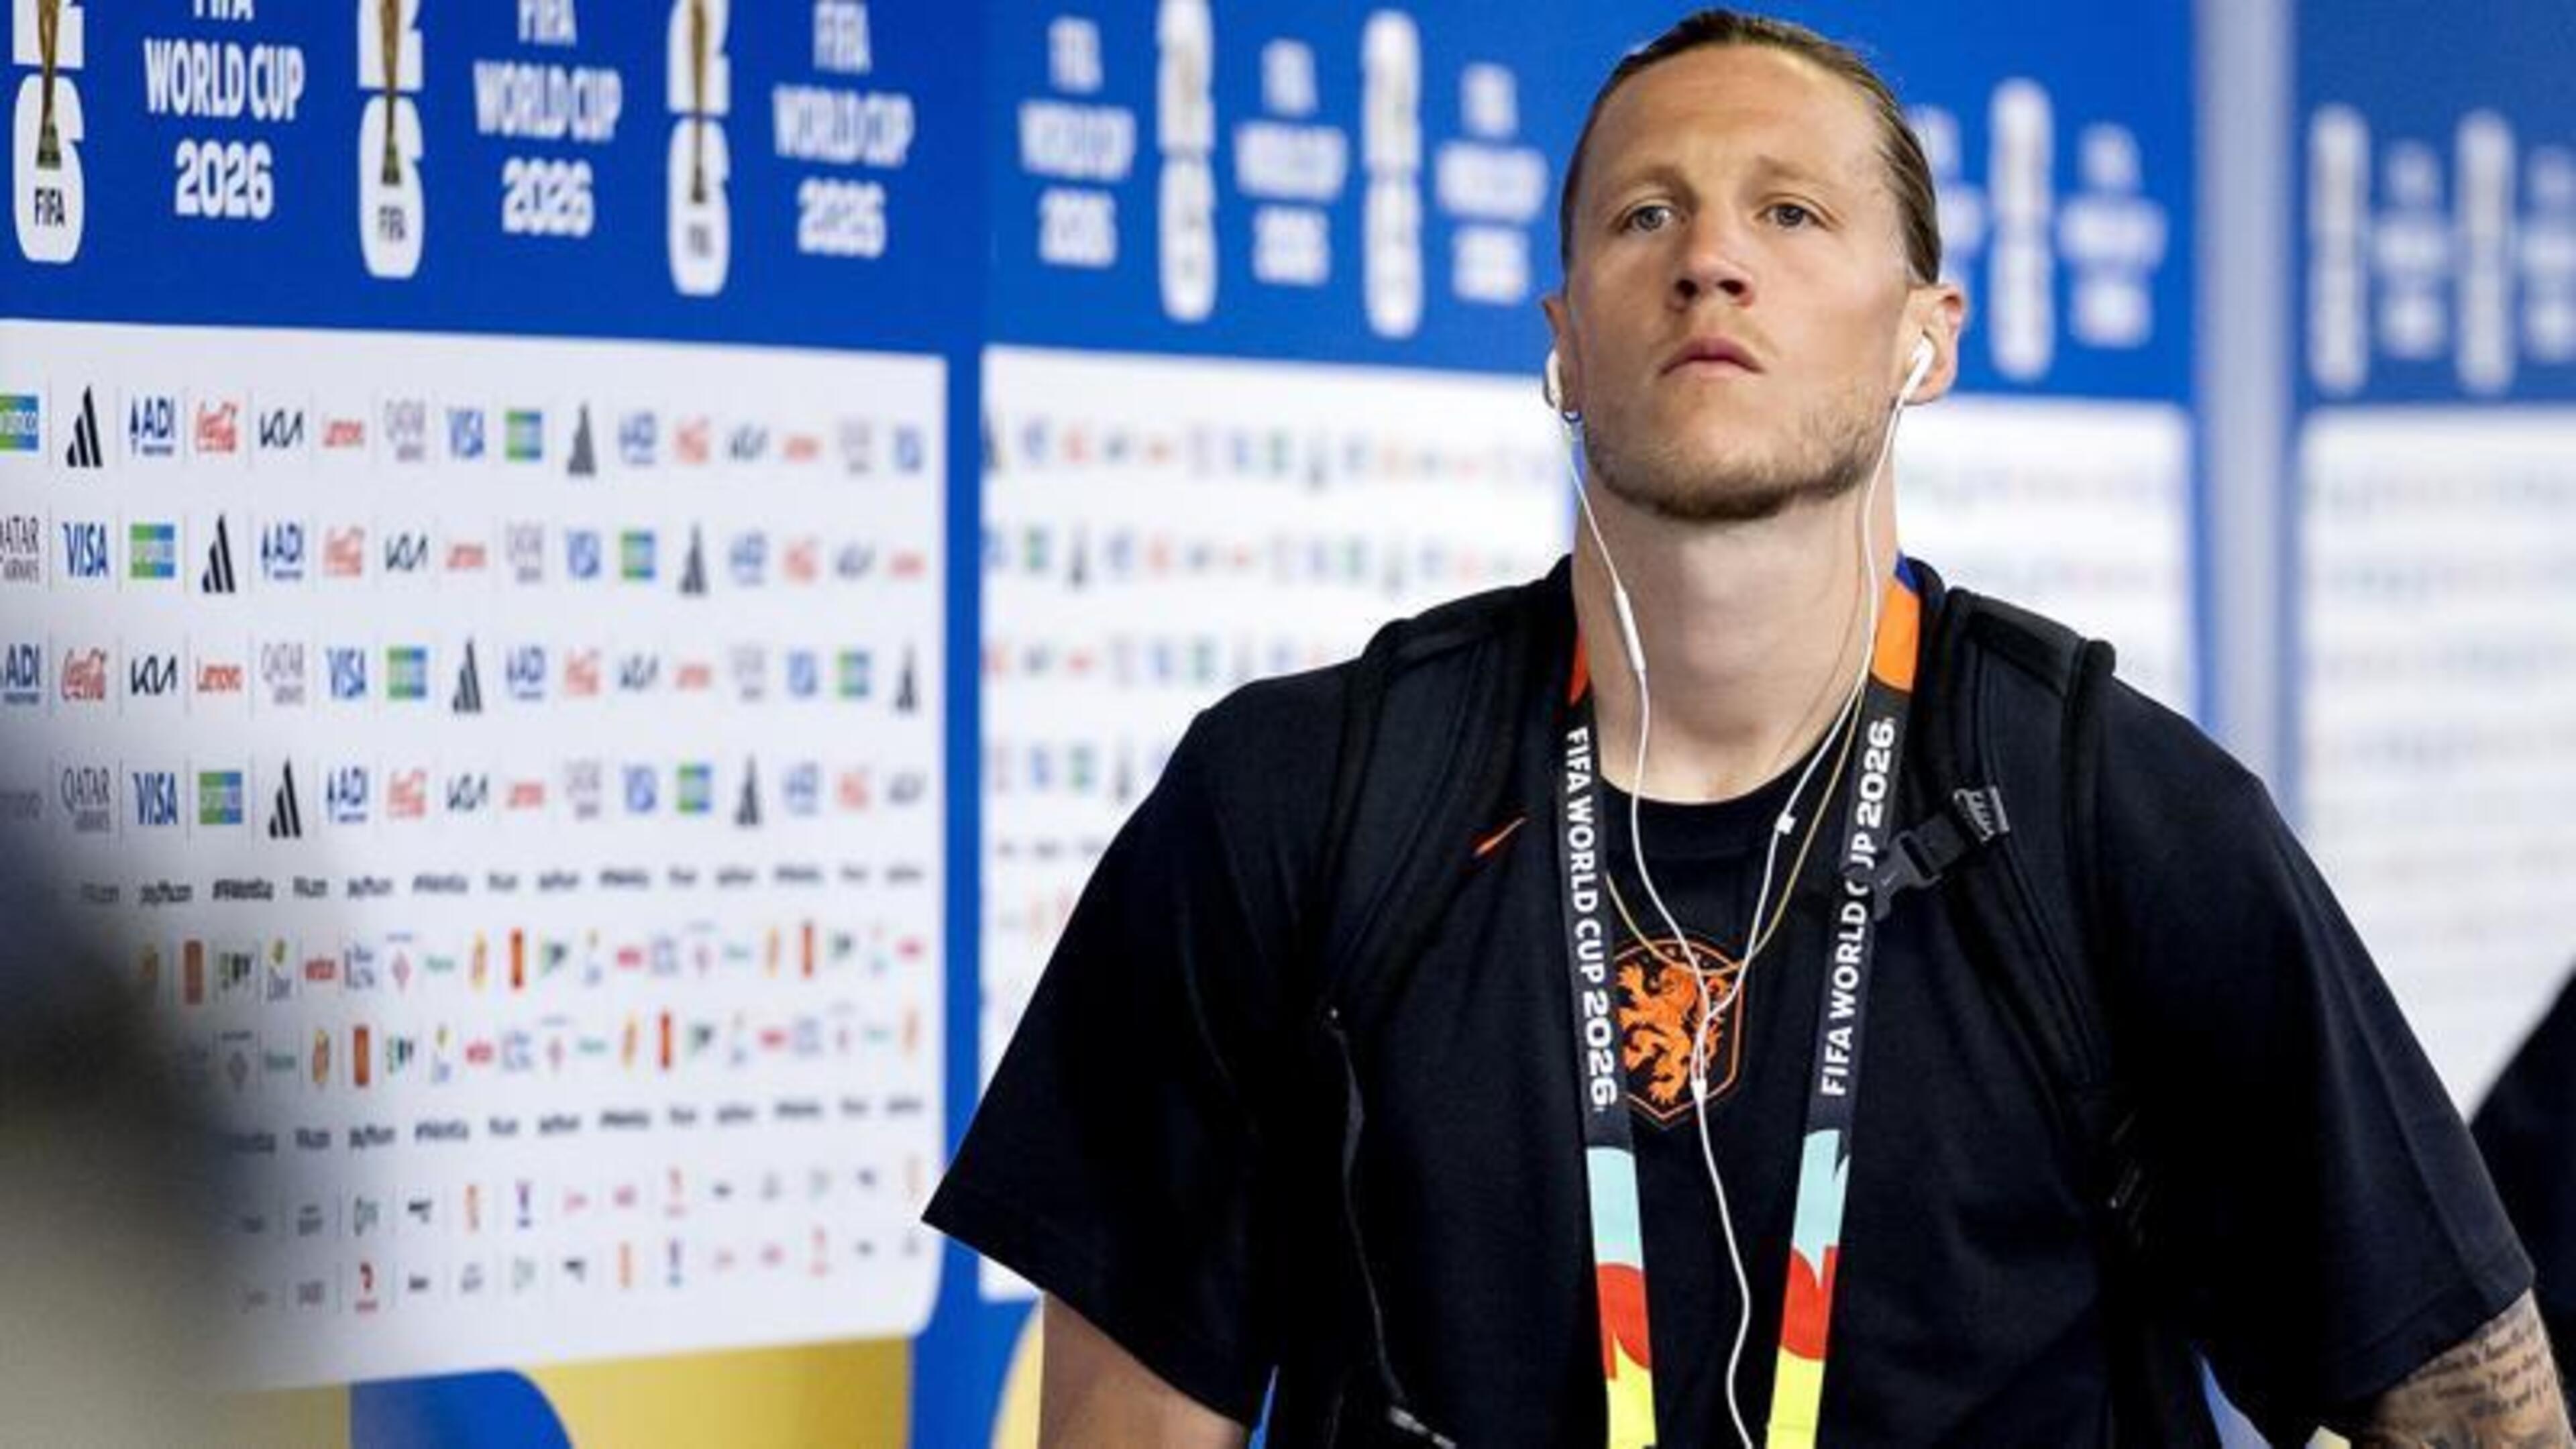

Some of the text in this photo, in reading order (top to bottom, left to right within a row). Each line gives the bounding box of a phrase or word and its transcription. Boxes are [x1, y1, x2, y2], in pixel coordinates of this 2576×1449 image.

[144, 38, 305, 121] WORLD CUP
[34, 188, 65, 226] FIFA
[174, 139, 274, 219] 2026
[142, 397, 174, 439] ADI
[0, 515, 39, 553] ATAR
[62, 521, 109, 578] VISA
[5, 644, 40, 688] ADI
[132, 772, 178, 826] VISA
[1856, 720, 1896, 829] 2026
[1566, 727, 1617, 1106] FIFA WORLD CUP 2026
[1828, 902, 1868, 1020] WORLD
[1820, 1026, 1853, 1097] FIFA
